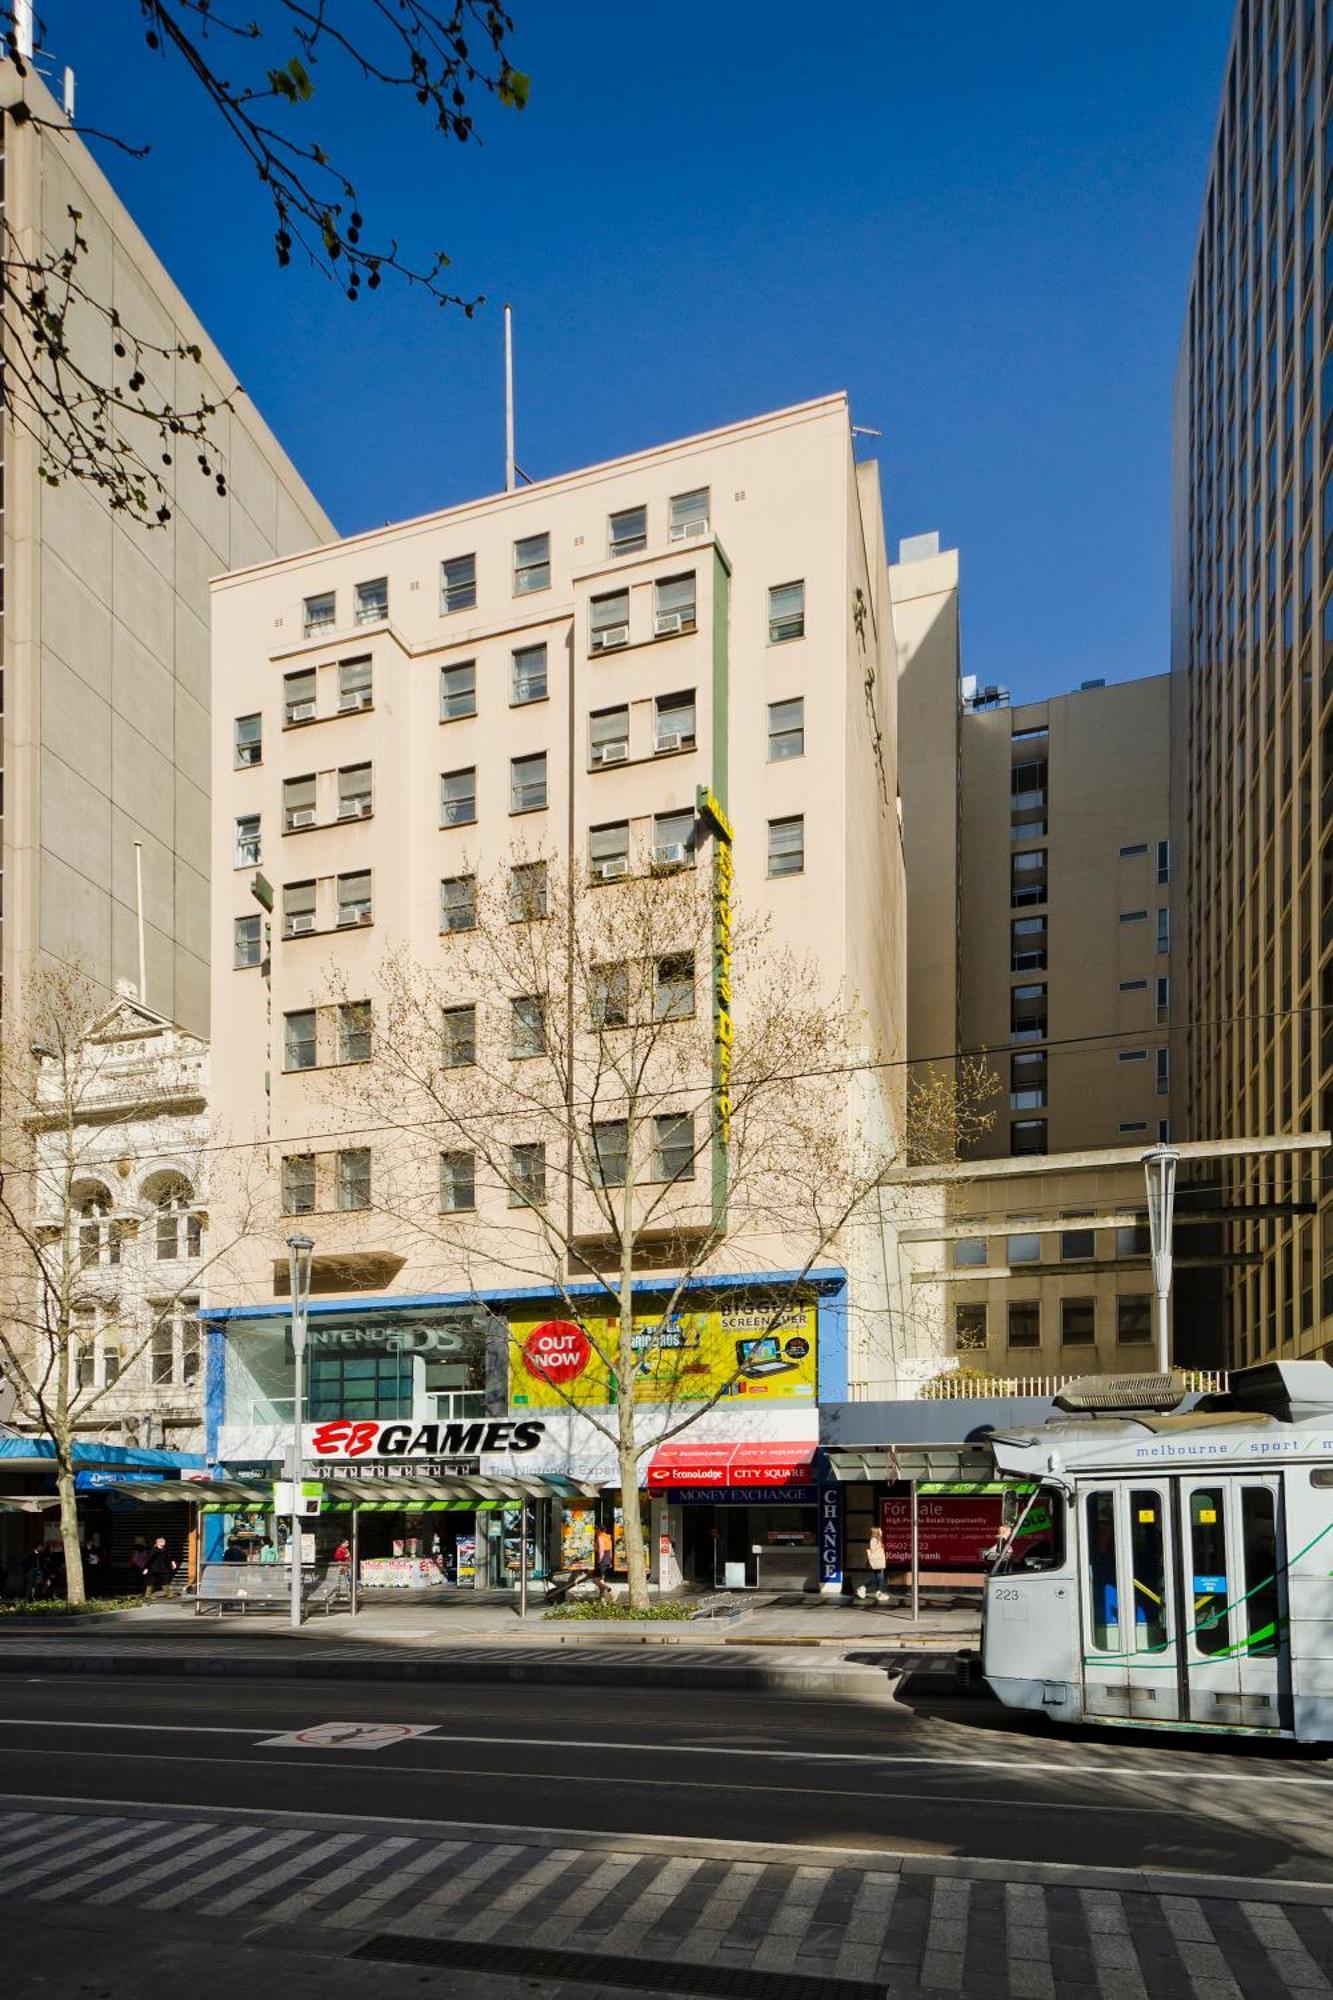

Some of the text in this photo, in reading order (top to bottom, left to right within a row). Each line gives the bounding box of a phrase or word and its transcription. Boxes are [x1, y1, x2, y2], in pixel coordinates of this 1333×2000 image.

[721, 1316, 770, 1328] SCREEN
[538, 1335, 576, 1351] OUT
[535, 1352, 580, 1368] NOW
[312, 1419, 546, 1457] EB GAMES
[1136, 1444, 1228, 1458] melbourne
[1250, 1440, 1299, 1456] sport
[491, 1465, 513, 1476] The
[516, 1464, 575, 1476] Nintendo
[672, 1468, 724, 1480] EconoLodge
[734, 1468, 807, 1479] CITY SQUARE
[679, 1487, 807, 1501] MONEY EXCHANGE
[884, 1502, 944, 1516] For ale
[823, 1489, 838, 1579] CHANGE
[885, 1551, 912, 1562] Knigh
[995, 1588, 1020, 1601] 223
